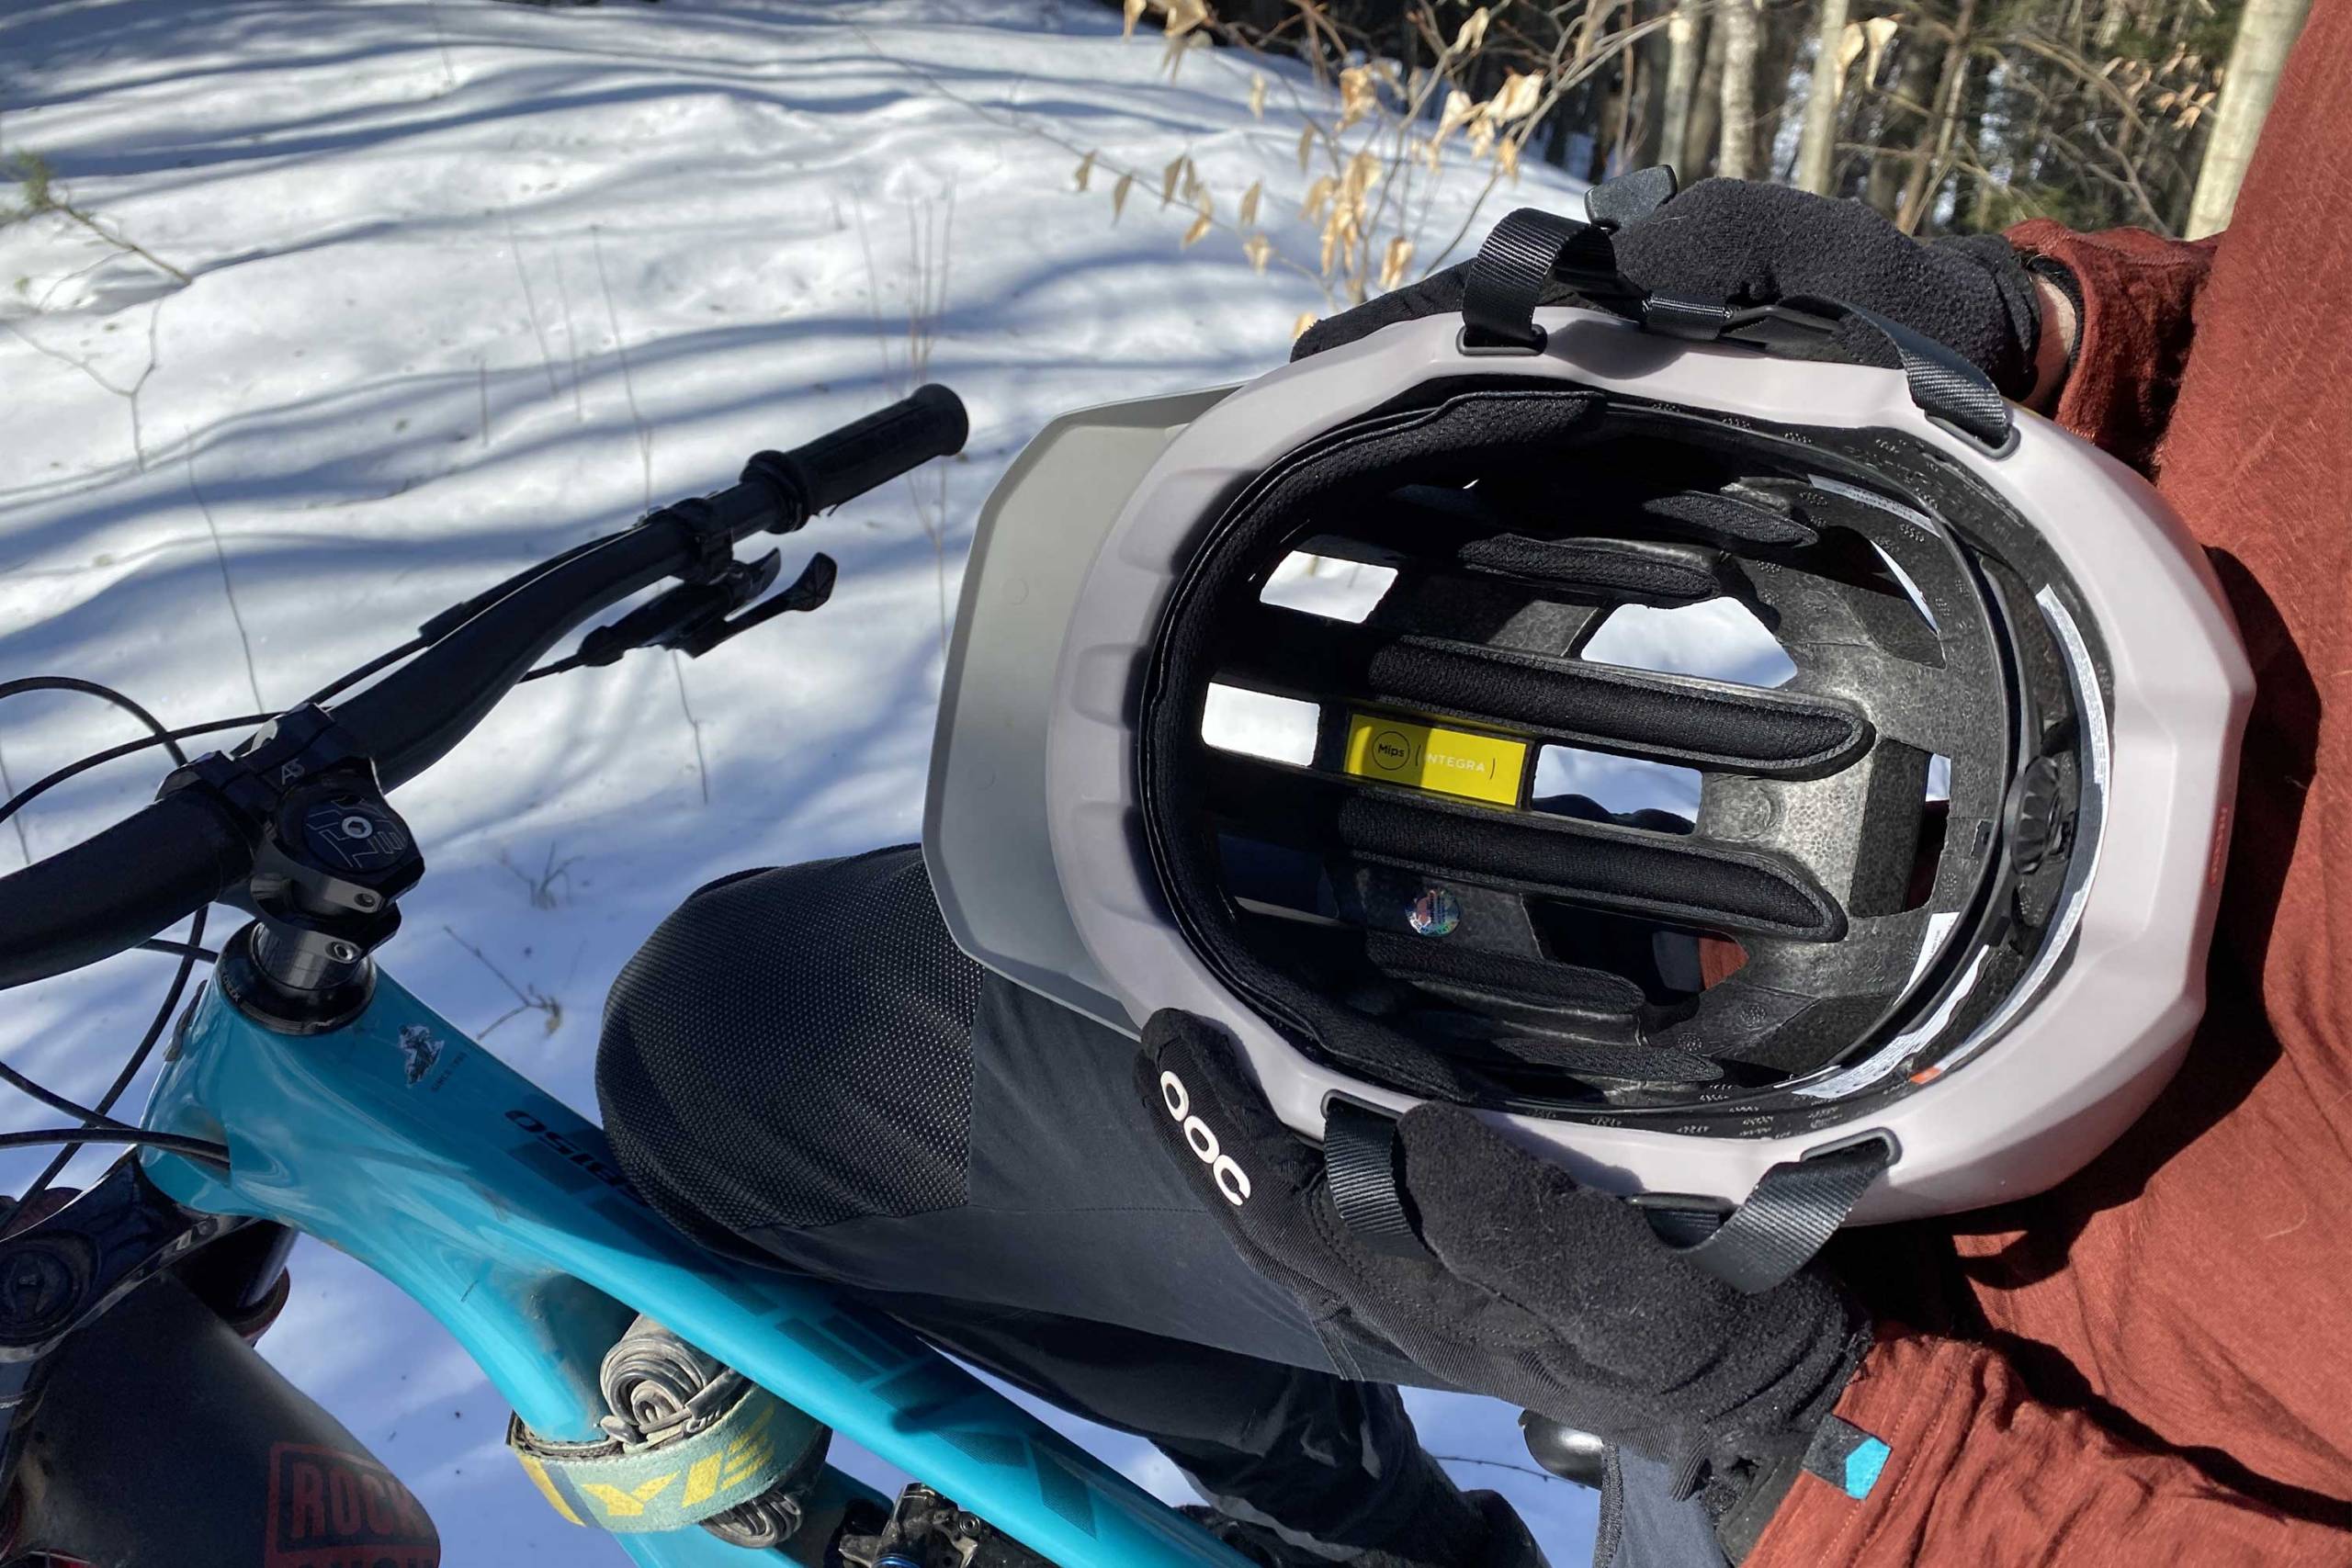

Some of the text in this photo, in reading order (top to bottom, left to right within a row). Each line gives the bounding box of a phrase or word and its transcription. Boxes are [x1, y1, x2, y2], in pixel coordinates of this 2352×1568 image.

[1377, 742, 1405, 759] Mips
[1423, 751, 1486, 773] NTEGRA
[290, 1461, 426, 1539] ROCK
